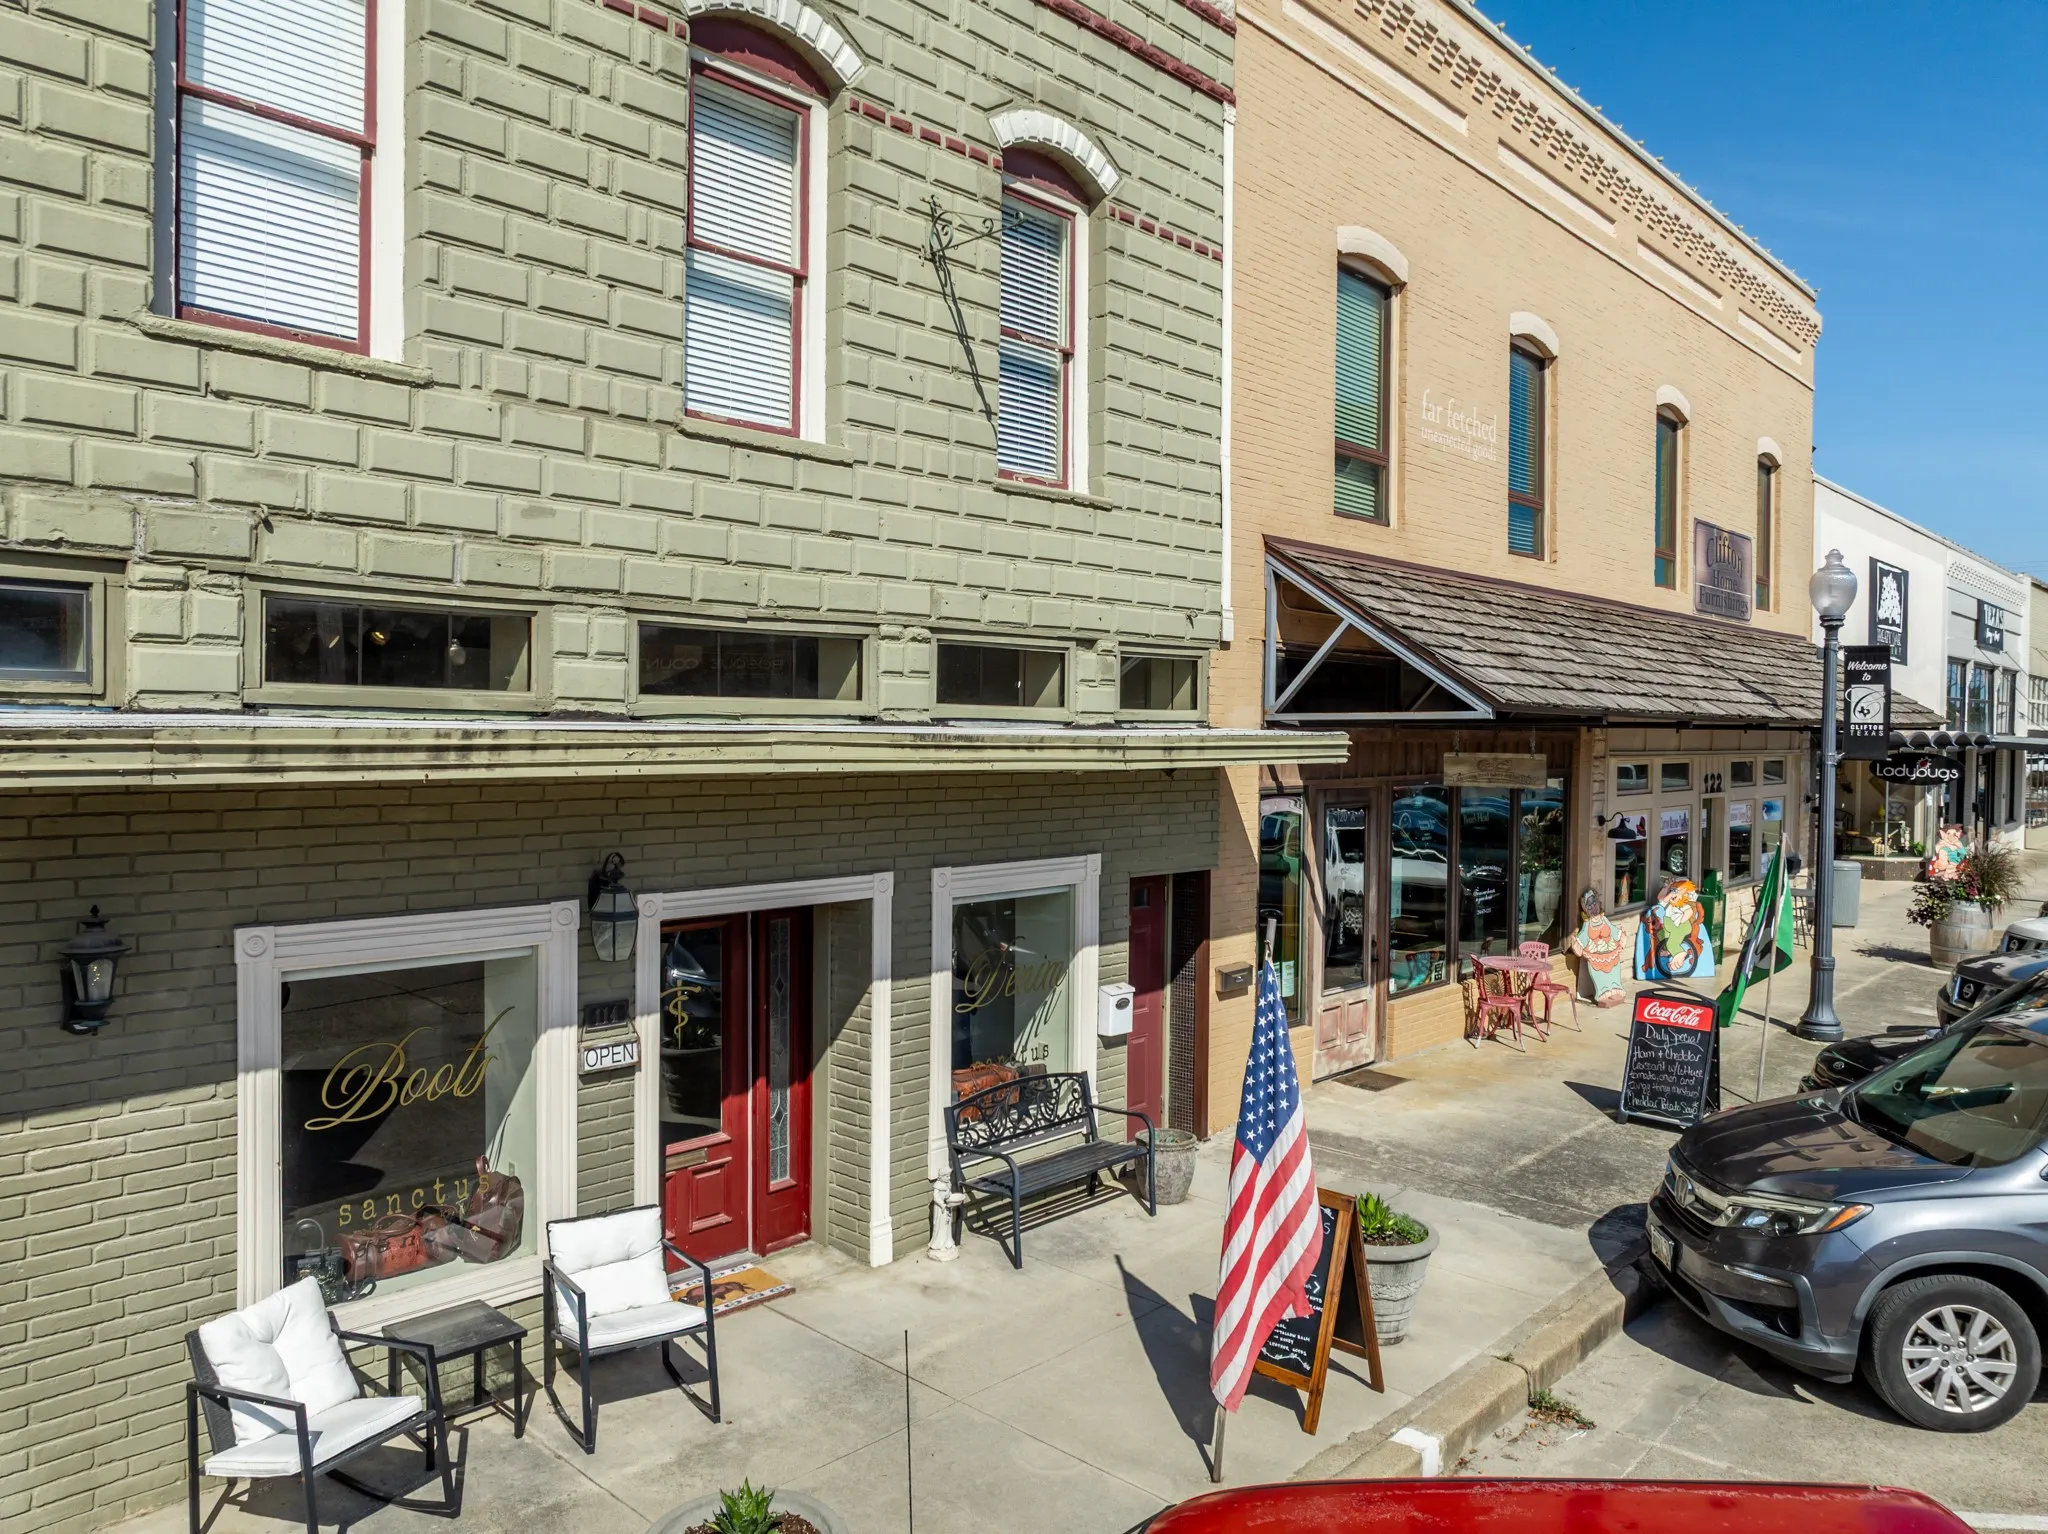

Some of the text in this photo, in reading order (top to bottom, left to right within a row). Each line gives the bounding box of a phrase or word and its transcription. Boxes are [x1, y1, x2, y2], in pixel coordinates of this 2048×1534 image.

[1422, 389, 1497, 443] far fetched
[1421, 427, 1497, 461] unexpected goods
[1707, 535, 1743, 578] Clifton
[1713, 569, 1737, 592] Home
[1699, 586, 1748, 617] Furnishings
[1984, 604, 2004, 630] TEXAS
[1847, 660, 1888, 671] Welcome
[1862, 672, 1872, 681] to
[1704, 772, 1722, 793] 122
[1876, 762, 1959, 781] Ladybugs
[955, 936, 1069, 1013] Denim
[1645, 1023, 1701, 1048] Daily Special
[586, 1042, 634, 1068] OPEN
[1633, 1045, 1655, 1061] Ham
[1665, 1048, 1702, 1062] Cheddar
[304, 1006, 515, 1131] Boots
[1679, 1076, 1696, 1085] and
[1658, 1097, 1681, 1111] Potato
[339, 1173, 490, 1227] sanctus
